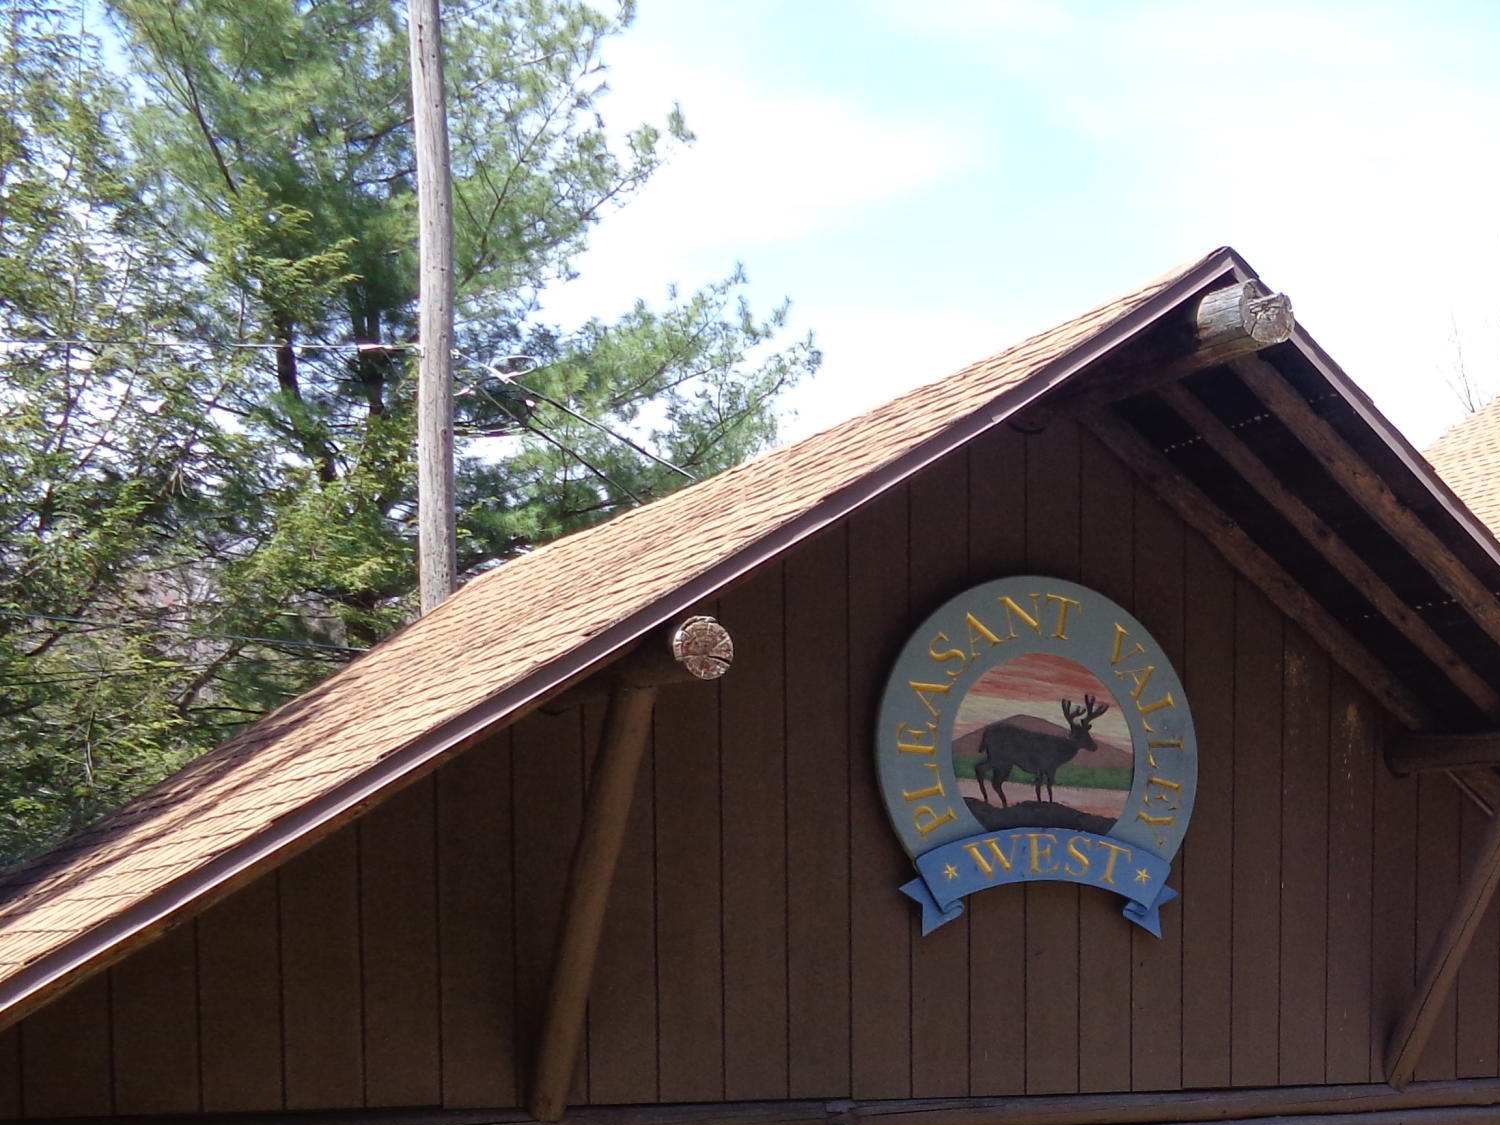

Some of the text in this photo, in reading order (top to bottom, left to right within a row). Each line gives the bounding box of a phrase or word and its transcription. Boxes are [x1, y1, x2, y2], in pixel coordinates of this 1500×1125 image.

[896, 592, 1185, 849] PLEASANT VALLEY
[963, 833, 1133, 885] WEST
